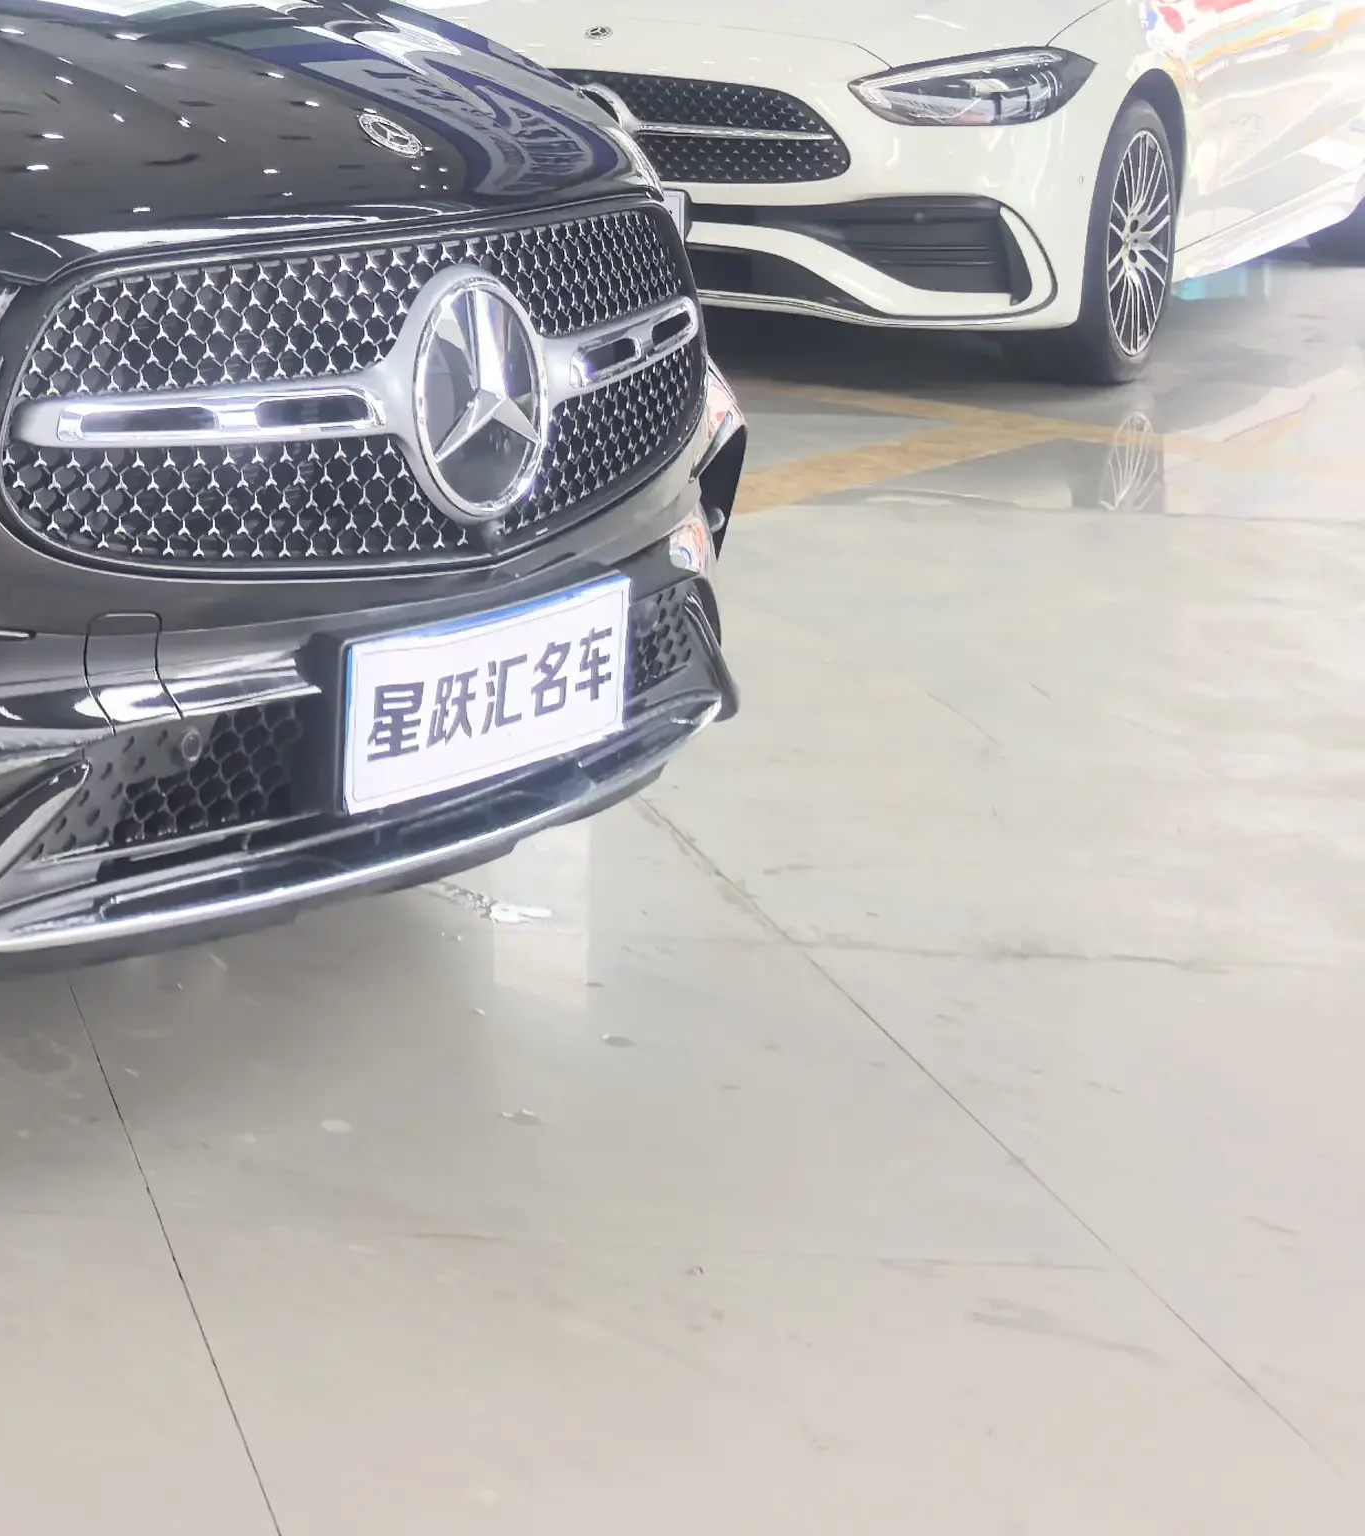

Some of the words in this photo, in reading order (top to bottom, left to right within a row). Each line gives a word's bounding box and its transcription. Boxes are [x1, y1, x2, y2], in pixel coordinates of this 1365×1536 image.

[367, 627, 613, 762] 星跃汇名车
